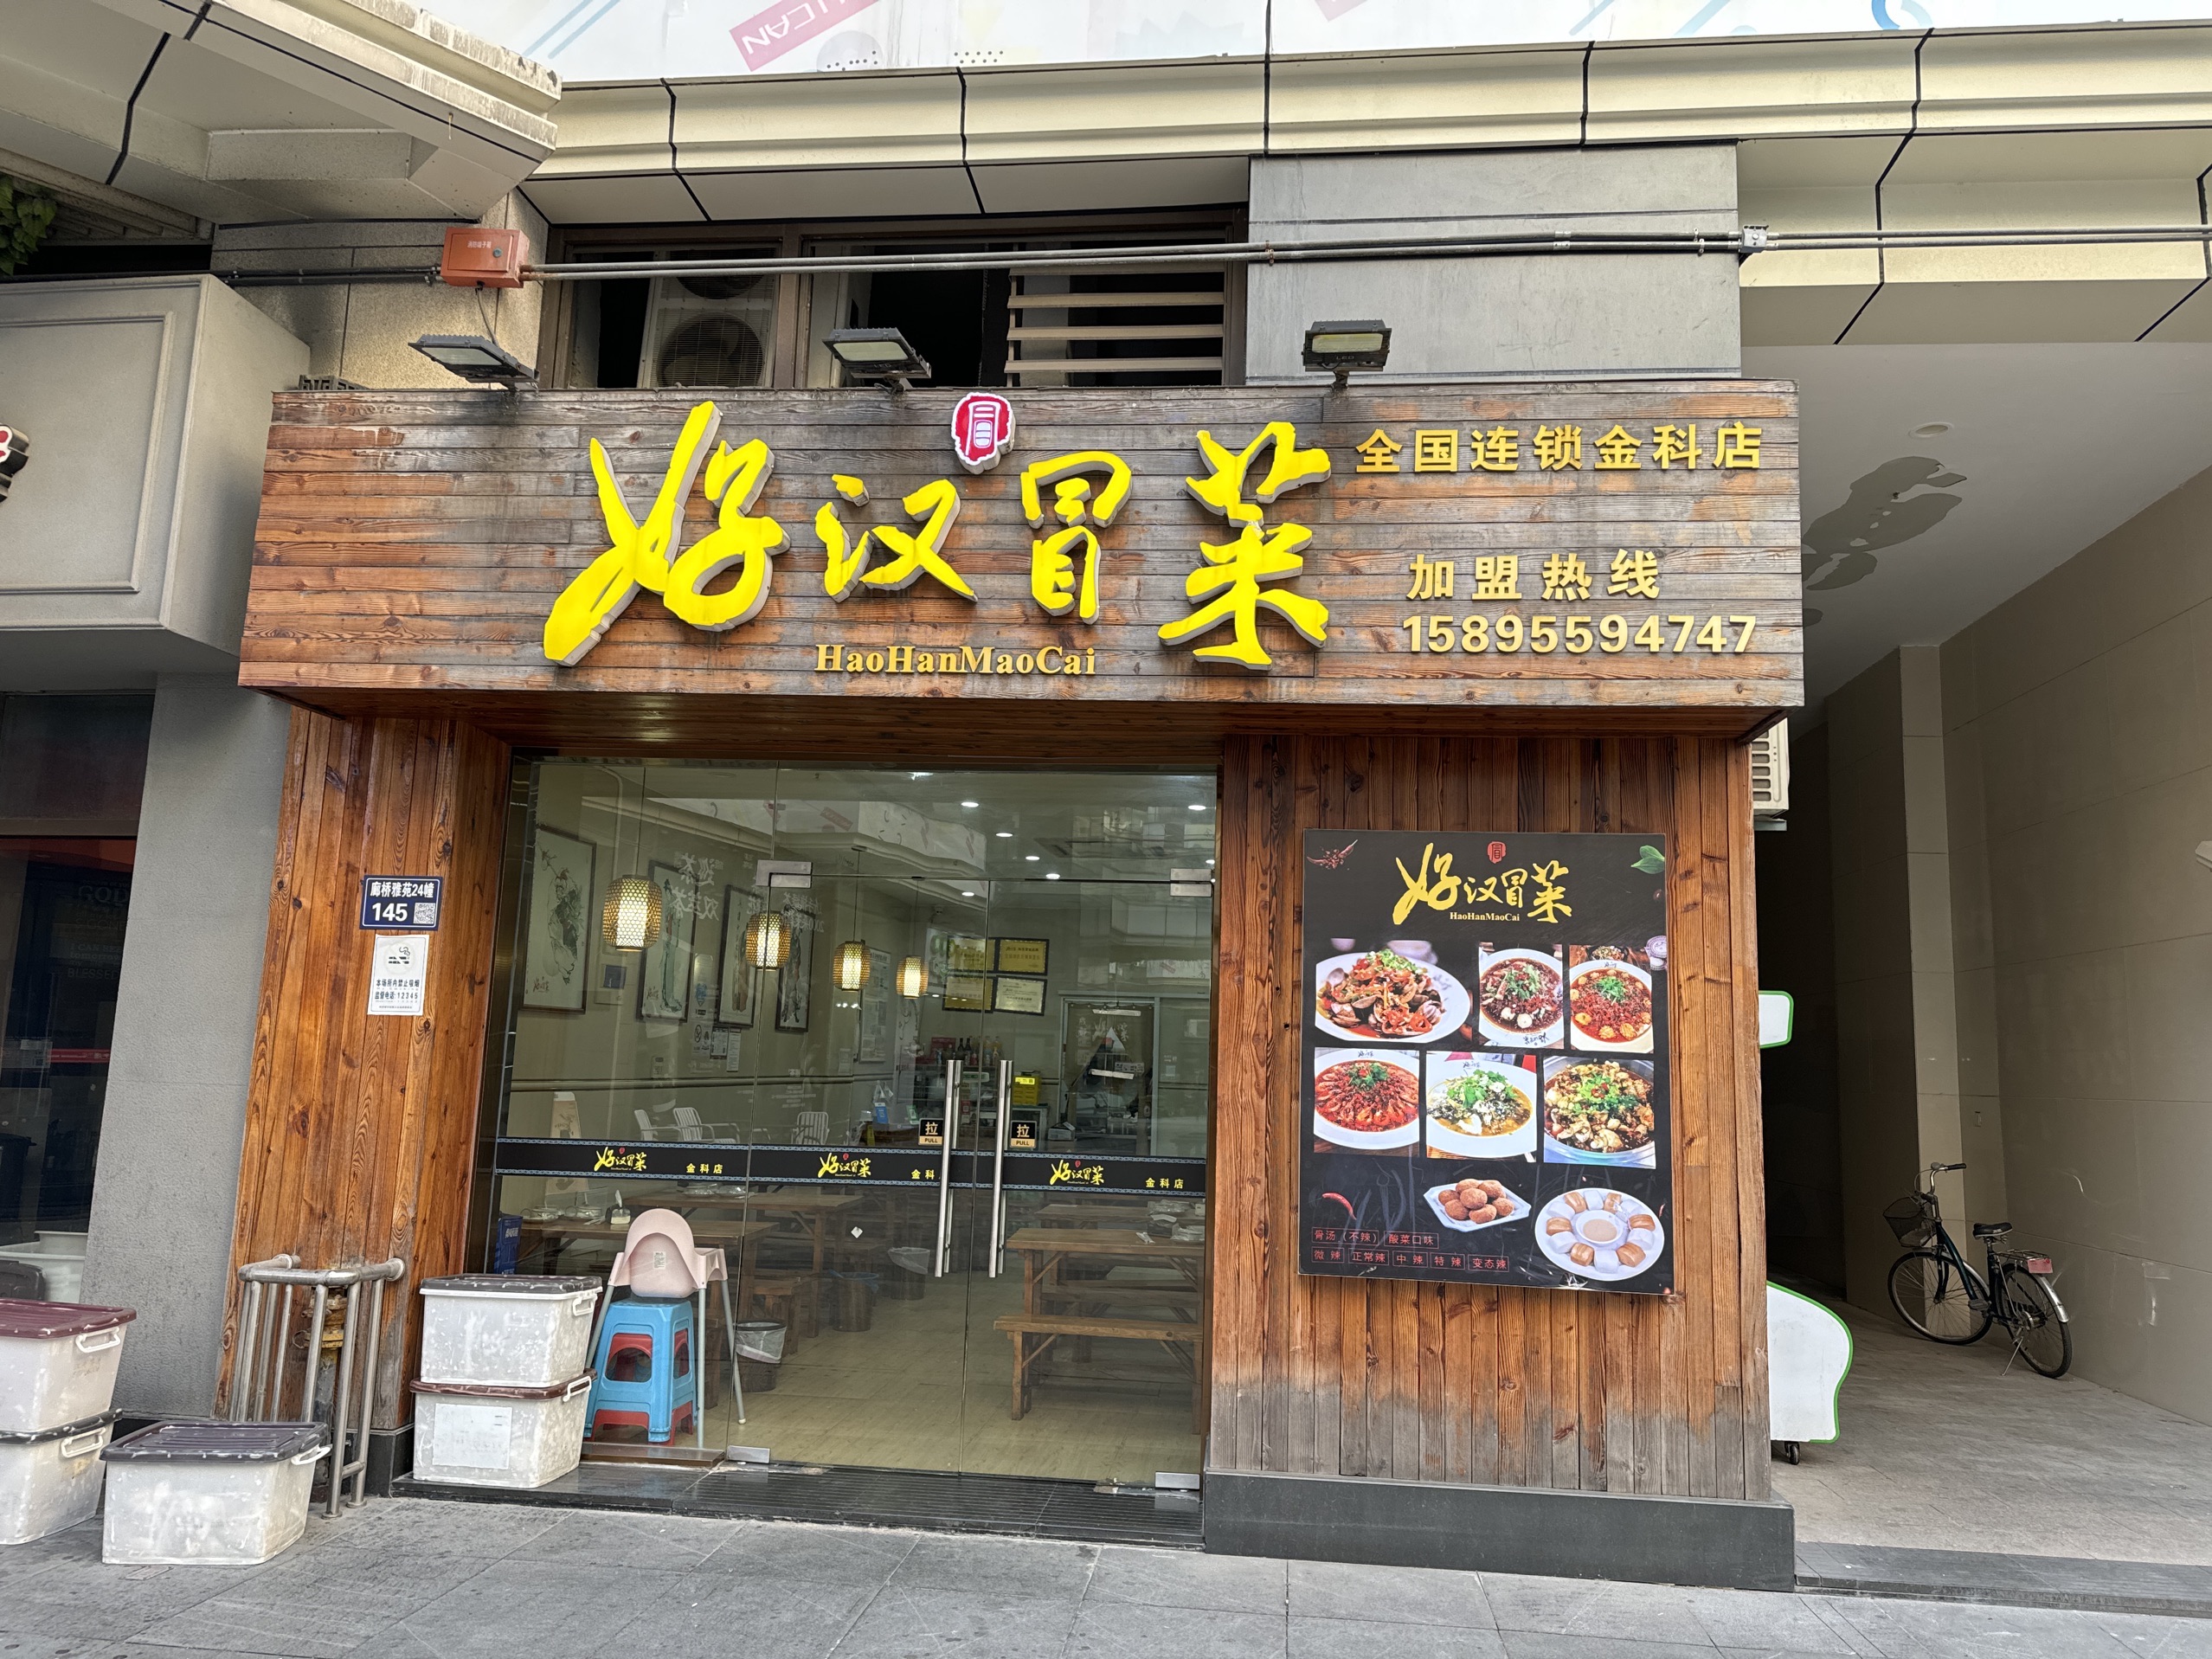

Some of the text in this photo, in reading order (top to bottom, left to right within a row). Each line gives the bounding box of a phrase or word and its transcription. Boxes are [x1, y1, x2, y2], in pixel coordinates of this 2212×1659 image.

[1355, 421, 1762, 473] 全国连锁金科店
[543, 400, 1331, 668] 好汉冒菜
[1406, 550, 1660, 601] 加盟热线
[1403, 615, 1757, 653] 15895594747
[815, 643, 1096, 675] HaoHanMaoCai
[370, 881, 434, 898] 廊桥雅苑24幢
[1392, 842, 1572, 925] 好汉冒菜
[372, 903, 408, 922] 145
[1450, 911, 1521, 922] HaoHanMaoCai
[925, 1122, 938, 1135] 拉
[1017, 1124, 1030, 1138] 拉
[594, 1147, 723, 1174] 好汉冒菜 金科店
[818, 1153, 942, 1180] 好汉冒菜 金科
[1050, 1160, 1184, 1189] 好汉冒菜 金科店
[1388, 1233, 1434, 1245] 酸菜口味
[1352, 1251, 1386, 1263] 正常辣
[1472, 1257, 1507, 1270] 变态辣
